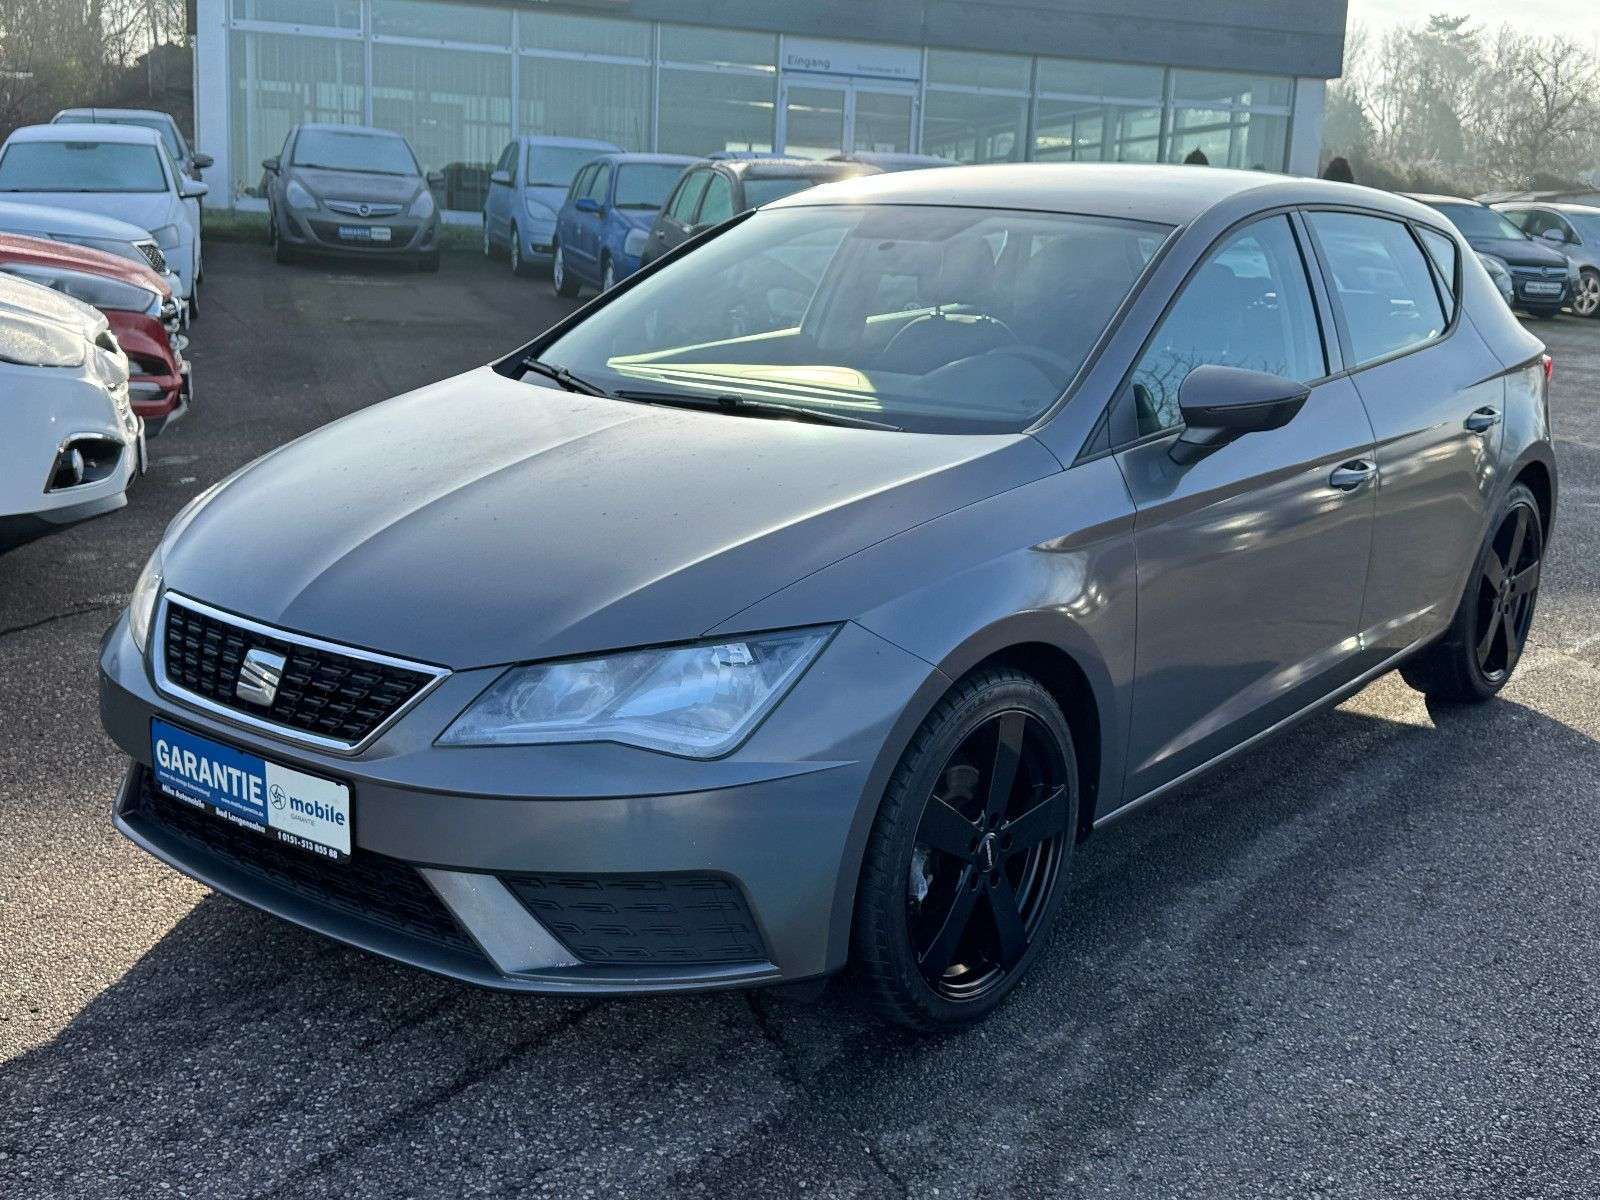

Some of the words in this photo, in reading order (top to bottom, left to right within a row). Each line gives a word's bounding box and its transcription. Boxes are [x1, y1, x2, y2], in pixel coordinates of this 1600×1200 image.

[787, 55, 831, 70] Eingang
[156, 739, 264, 806] GARANTIE
[215, 807, 228, 819] Bad
[290, 797, 345, 826] mobile
